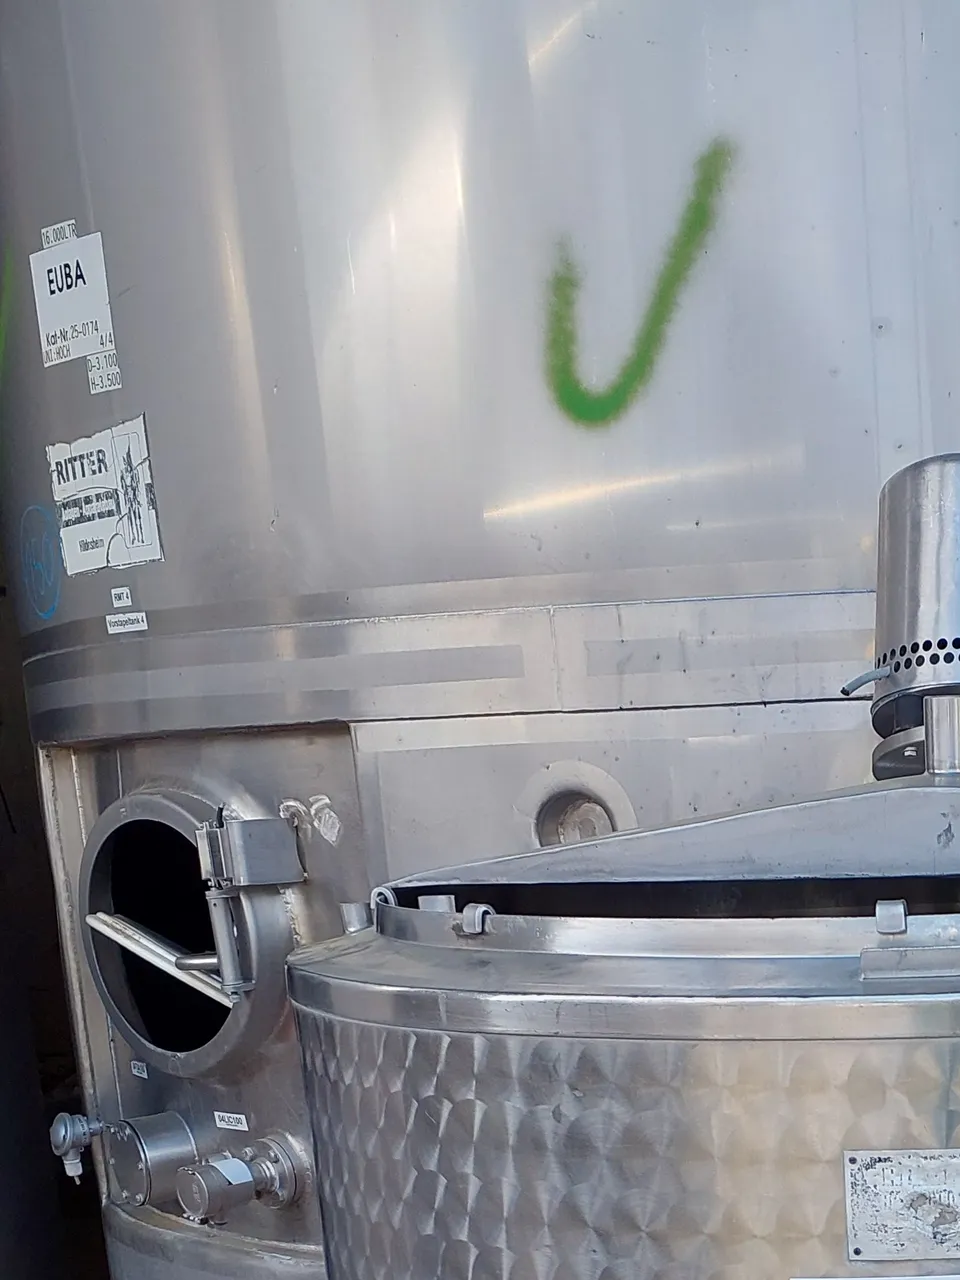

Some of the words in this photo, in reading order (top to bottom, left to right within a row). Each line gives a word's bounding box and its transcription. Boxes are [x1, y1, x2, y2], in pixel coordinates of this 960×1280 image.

[47, 260, 86, 295] EUBA
[91, 372, 120, 390] H-3.500
[55, 449, 108, 485] RITTER
